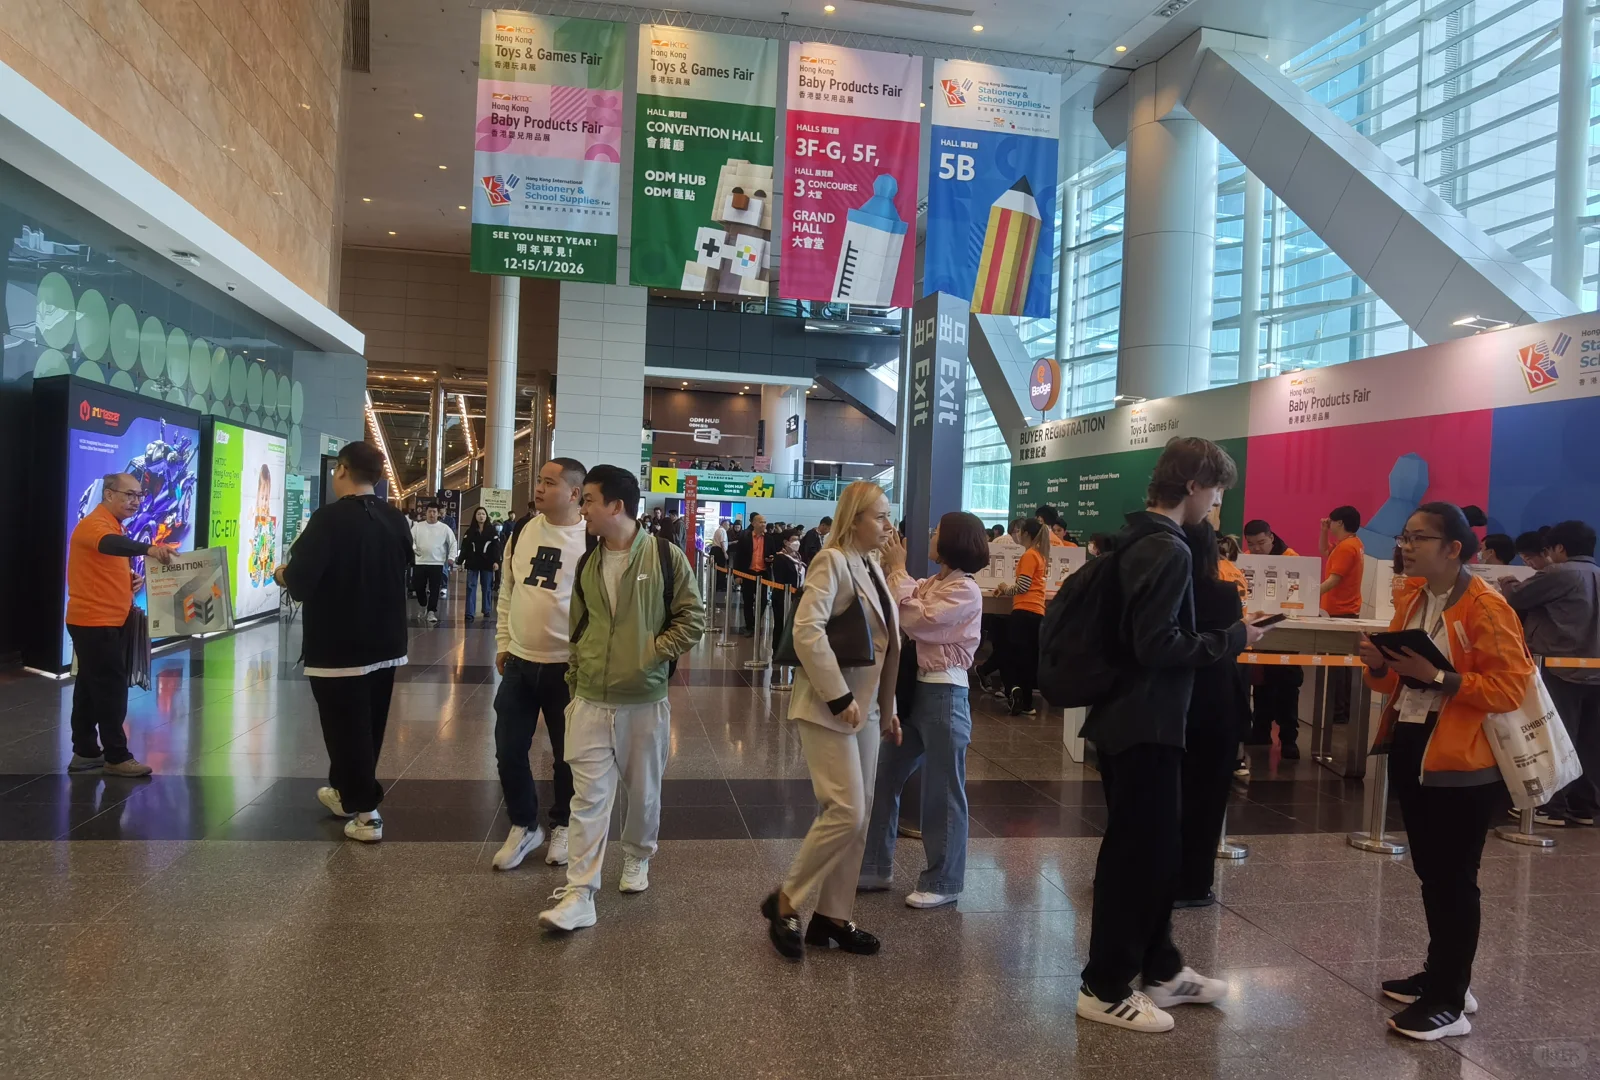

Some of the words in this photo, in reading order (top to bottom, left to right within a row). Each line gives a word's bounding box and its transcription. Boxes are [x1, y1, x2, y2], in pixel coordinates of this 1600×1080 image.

[495, 34, 513, 44] Hong
[515, 36, 532, 45] Kong
[495, 45, 521, 60] Toys
[525, 47, 533, 60] &
[537, 48, 576, 64] Games
[581, 53, 603, 66] Fair
[651, 48, 667, 58] Hong
[670, 50, 686, 60] Kong
[494, 61, 537, 71] 香港玩具展
[651, 58, 676, 75] Toys
[680, 62, 688, 74] &
[692, 63, 729, 79] Games
[733, 68, 754, 81] Fair
[799, 65, 816, 75] Hong
[818, 66, 834, 76] Kong
[650, 74, 690, 86] 香港玩具展
[799, 75, 826, 91] Baby
[830, 78, 879, 95] Products
[883, 84, 903, 97] Fair
[799, 90, 854, 104] 香港嬰兒用品展
[978, 87, 1021, 99] Stationery
[492, 102, 509, 112] Hong
[512, 104, 529, 114] Kong
[978, 95, 1006, 104] School
[1007, 98, 1041, 108] Supplies
[647, 108, 667, 117] HALL
[491, 113, 520, 129] Baby
[524, 116, 577, 132] Products
[582, 121, 603, 134] Fair
[796, 124, 820, 132] HALLS
[491, 129, 550, 142] 香港嬰兒用品展
[646, 121, 730, 139] CONVENTION
[732, 131, 763, 143] HALL
[646, 136, 685, 152] 會議廳
[940, 139, 959, 147] HALL
[795, 138, 846, 163] 3F-G,
[852, 144, 879, 166] 5F,
[795, 168, 813, 176] HALL
[939, 152, 975, 181] 5B
[645, 170, 676, 183] ODM
[678, 173, 706, 186] HUB
[525, 183, 575, 195] Stationery
[644, 186, 671, 198] ODM
[794, 179, 805, 197] 3
[808, 180, 857, 191] CONCOURSE
[808, 190, 822, 199] 大堂
[525, 191, 557, 201] School
[560, 194, 600, 205] Supplies
[793, 210, 835, 223] GRAND
[792, 222, 822, 234] HALL
[492, 231, 509, 240] SEE
[512, 232, 534, 241] YOU
[537, 234, 563, 243] NEXT
[792, 236, 824, 250] 大會堂
[504, 258, 584, 274] 12-15/1/2026
[914, 317, 935, 348] 出口
[939, 314, 966, 346] 出口
[914, 358, 930, 427] Exit
[939, 357, 960, 426] Exit
[1032, 383, 1051, 396] Badge
[1289, 399, 1308, 413] Baby
[1311, 392, 1350, 409] Products
[1353, 388, 1371, 403] Fair
[1020, 429, 1043, 445] BUYER
[1045, 415, 1105, 440] REGISTRATION
[1131, 425, 1142, 437] Toys
[1143, 424, 1147, 433] &
[1148, 422, 1167, 433] Games
[1168, 418, 1180, 430] Fair
[1020, 446, 1046, 461] 買家登記處
[1089, 473, 1108, 482] Registration
[211, 520, 237, 538] 1C-E17
[1520, 710, 1555, 734] EXHIBITION
